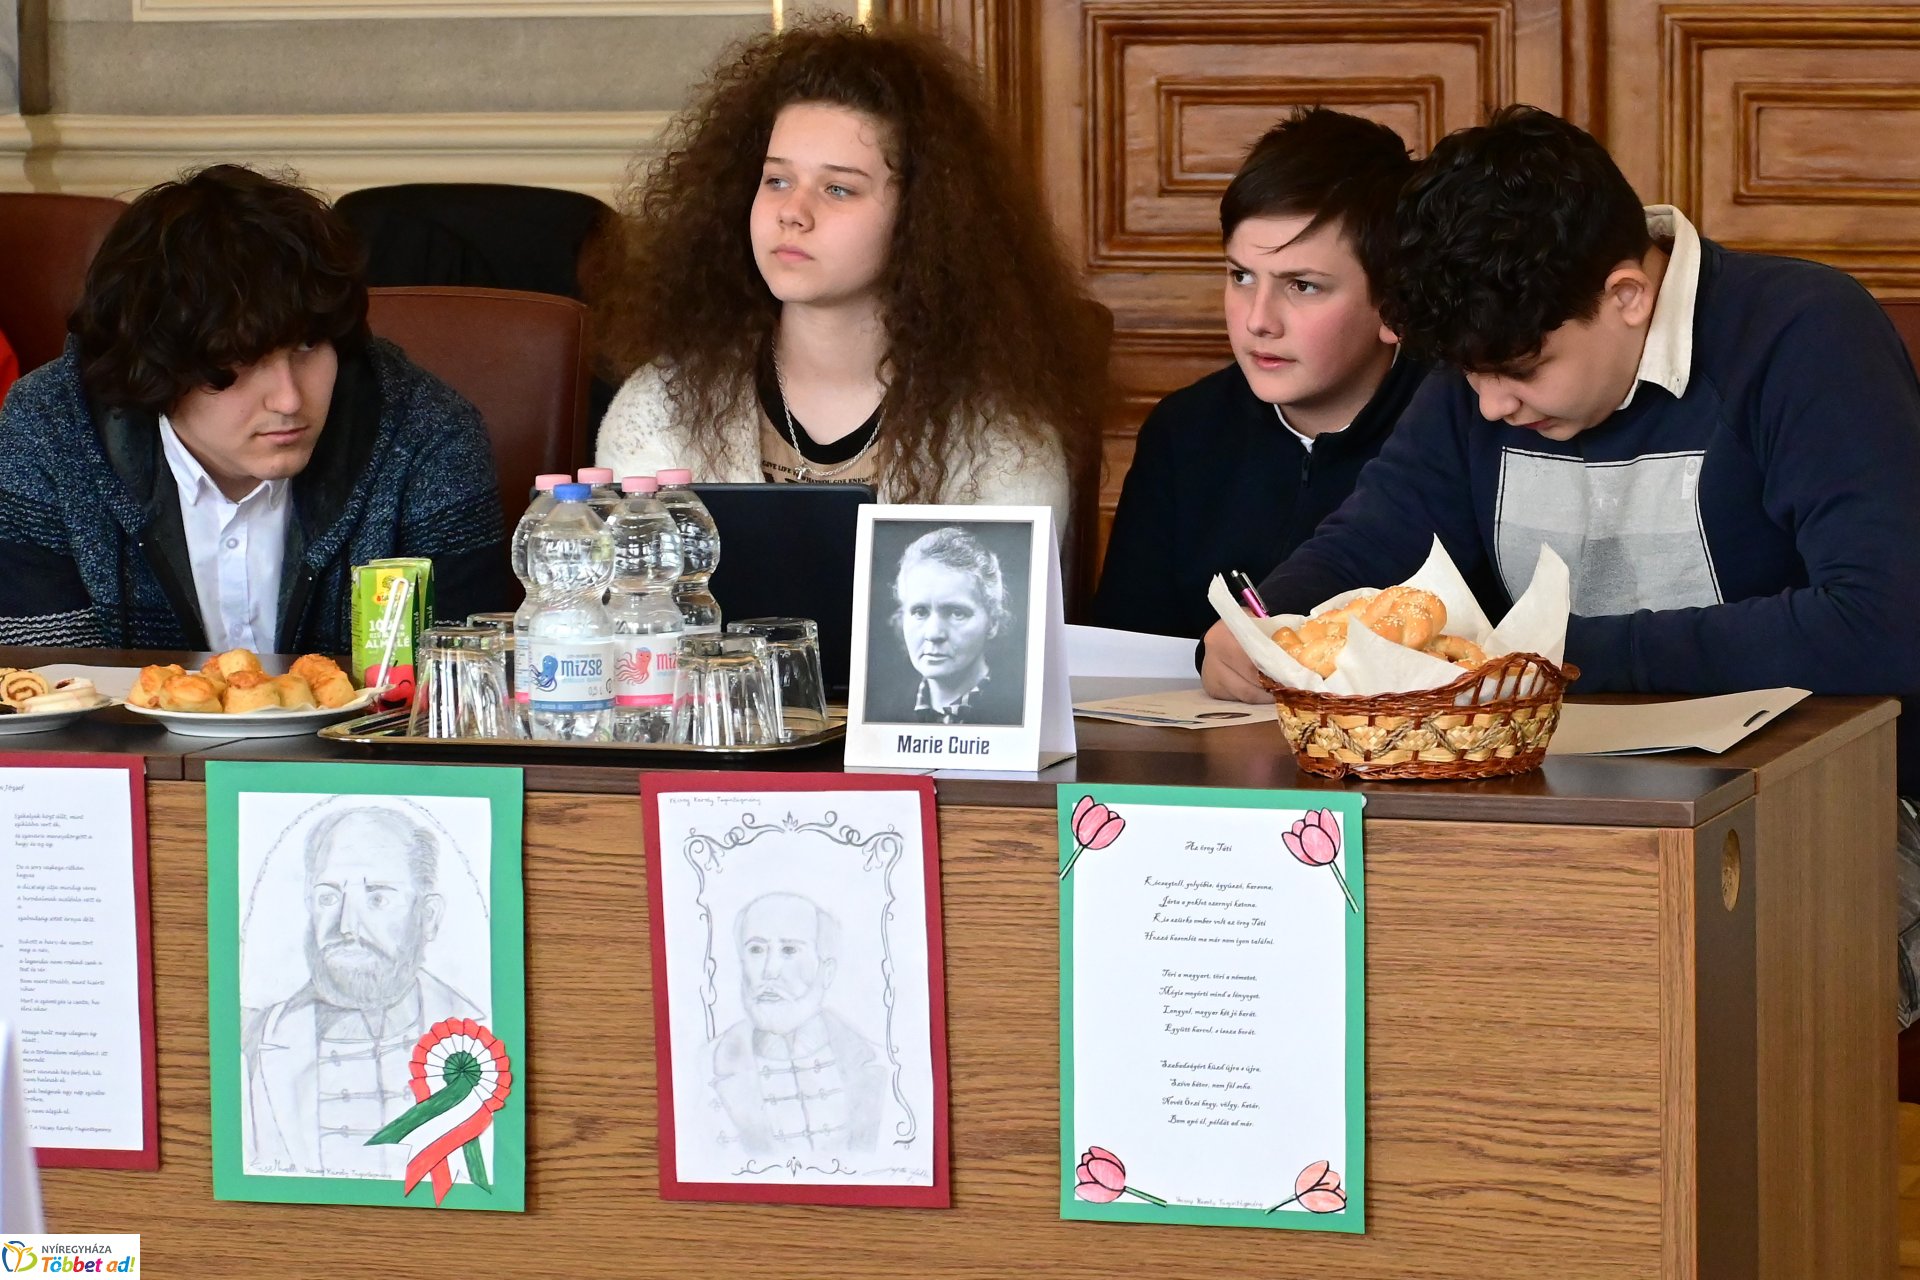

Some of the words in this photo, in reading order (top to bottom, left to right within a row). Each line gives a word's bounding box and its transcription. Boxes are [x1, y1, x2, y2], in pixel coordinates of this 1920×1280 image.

[560, 659, 603, 677] mizse
[897, 735, 942, 754] Marie
[949, 736, 990, 755] Curie
[1185, 841, 1199, 851] Az
